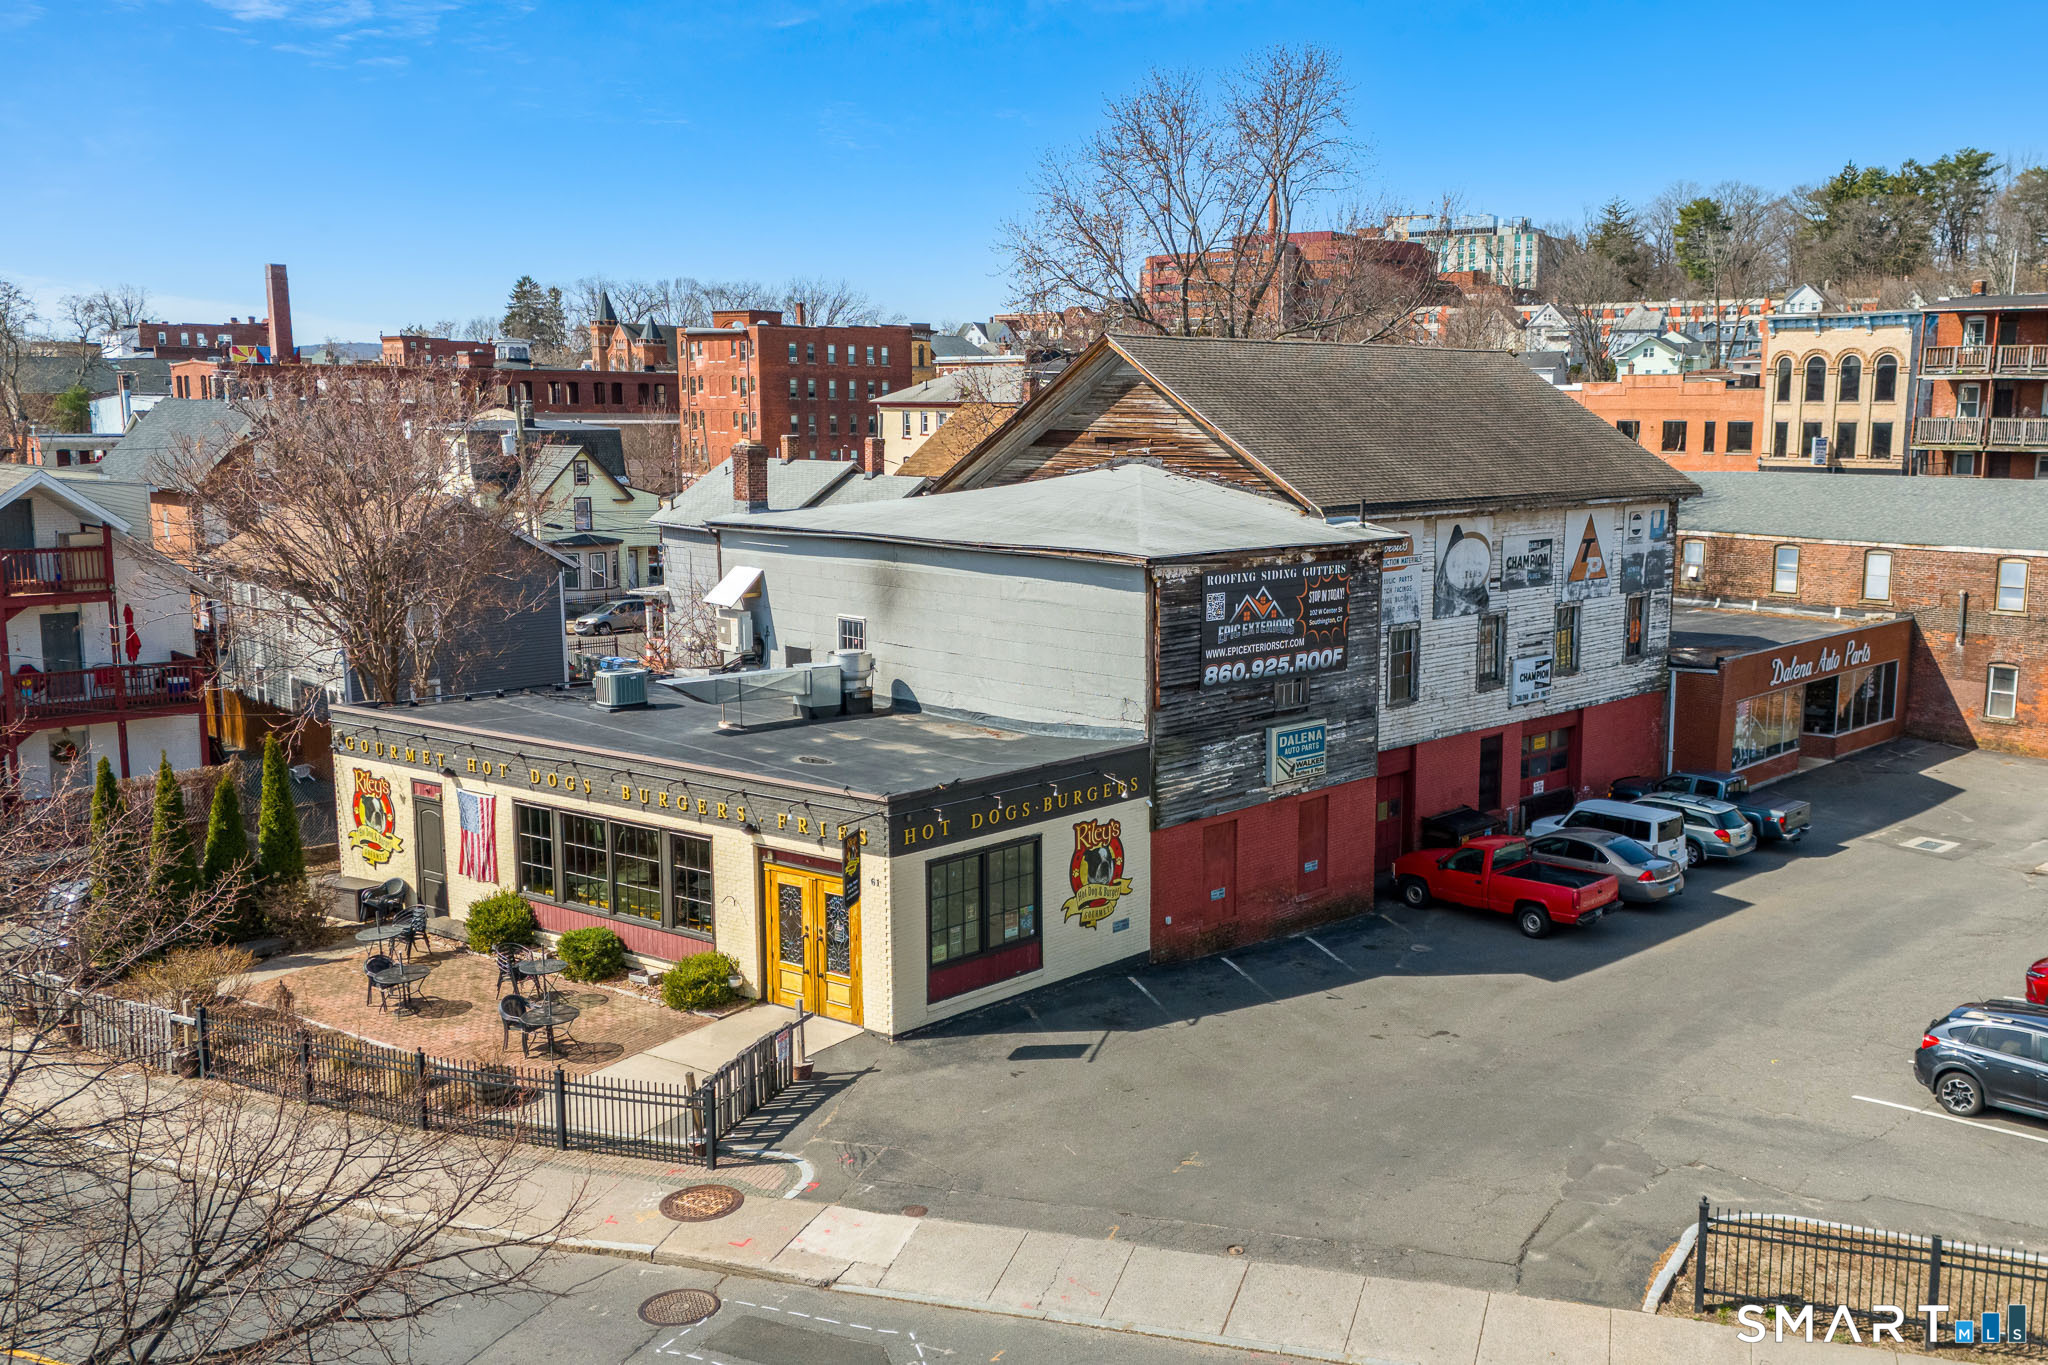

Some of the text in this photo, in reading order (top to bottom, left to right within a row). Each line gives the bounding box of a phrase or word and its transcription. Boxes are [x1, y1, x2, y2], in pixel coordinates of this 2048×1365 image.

[1506, 553, 1549, 569] CHAMPION
[1207, 564, 1346, 586] ROOFING SIDING GUTTERS
[1308, 587, 1345, 604] STOP IN TODAY!
[1217, 618, 1295, 645] EPIC EXTERIORS
[1205, 637, 1305, 659] WWW.EPICEXTERIORSCT.COM
[1203, 647, 1344, 686] 860.925.ROOF
[1769, 639, 1871, 686] Dalena Auto Parts
[1520, 670, 1550, 683] CHAMPION
[1279, 729, 1323, 748] DALENA
[1284, 742, 1320, 755] AUTO PARTS
[1296, 756, 1324, 768] WALKER
[345, 736, 868, 846] GOURMET HOT DOGS BURGERS FRIES
[354, 769, 390, 799] Riley's
[903, 776, 1139, 846] HOT DOGS BURGERS
[1076, 820, 1120, 850] Riley's
[870, 877, 881, 887] 61
[1078, 888, 1087, 901] Hot
[1088, 886, 1098, 897] Dog
[1103, 886, 1120, 899] Burger
